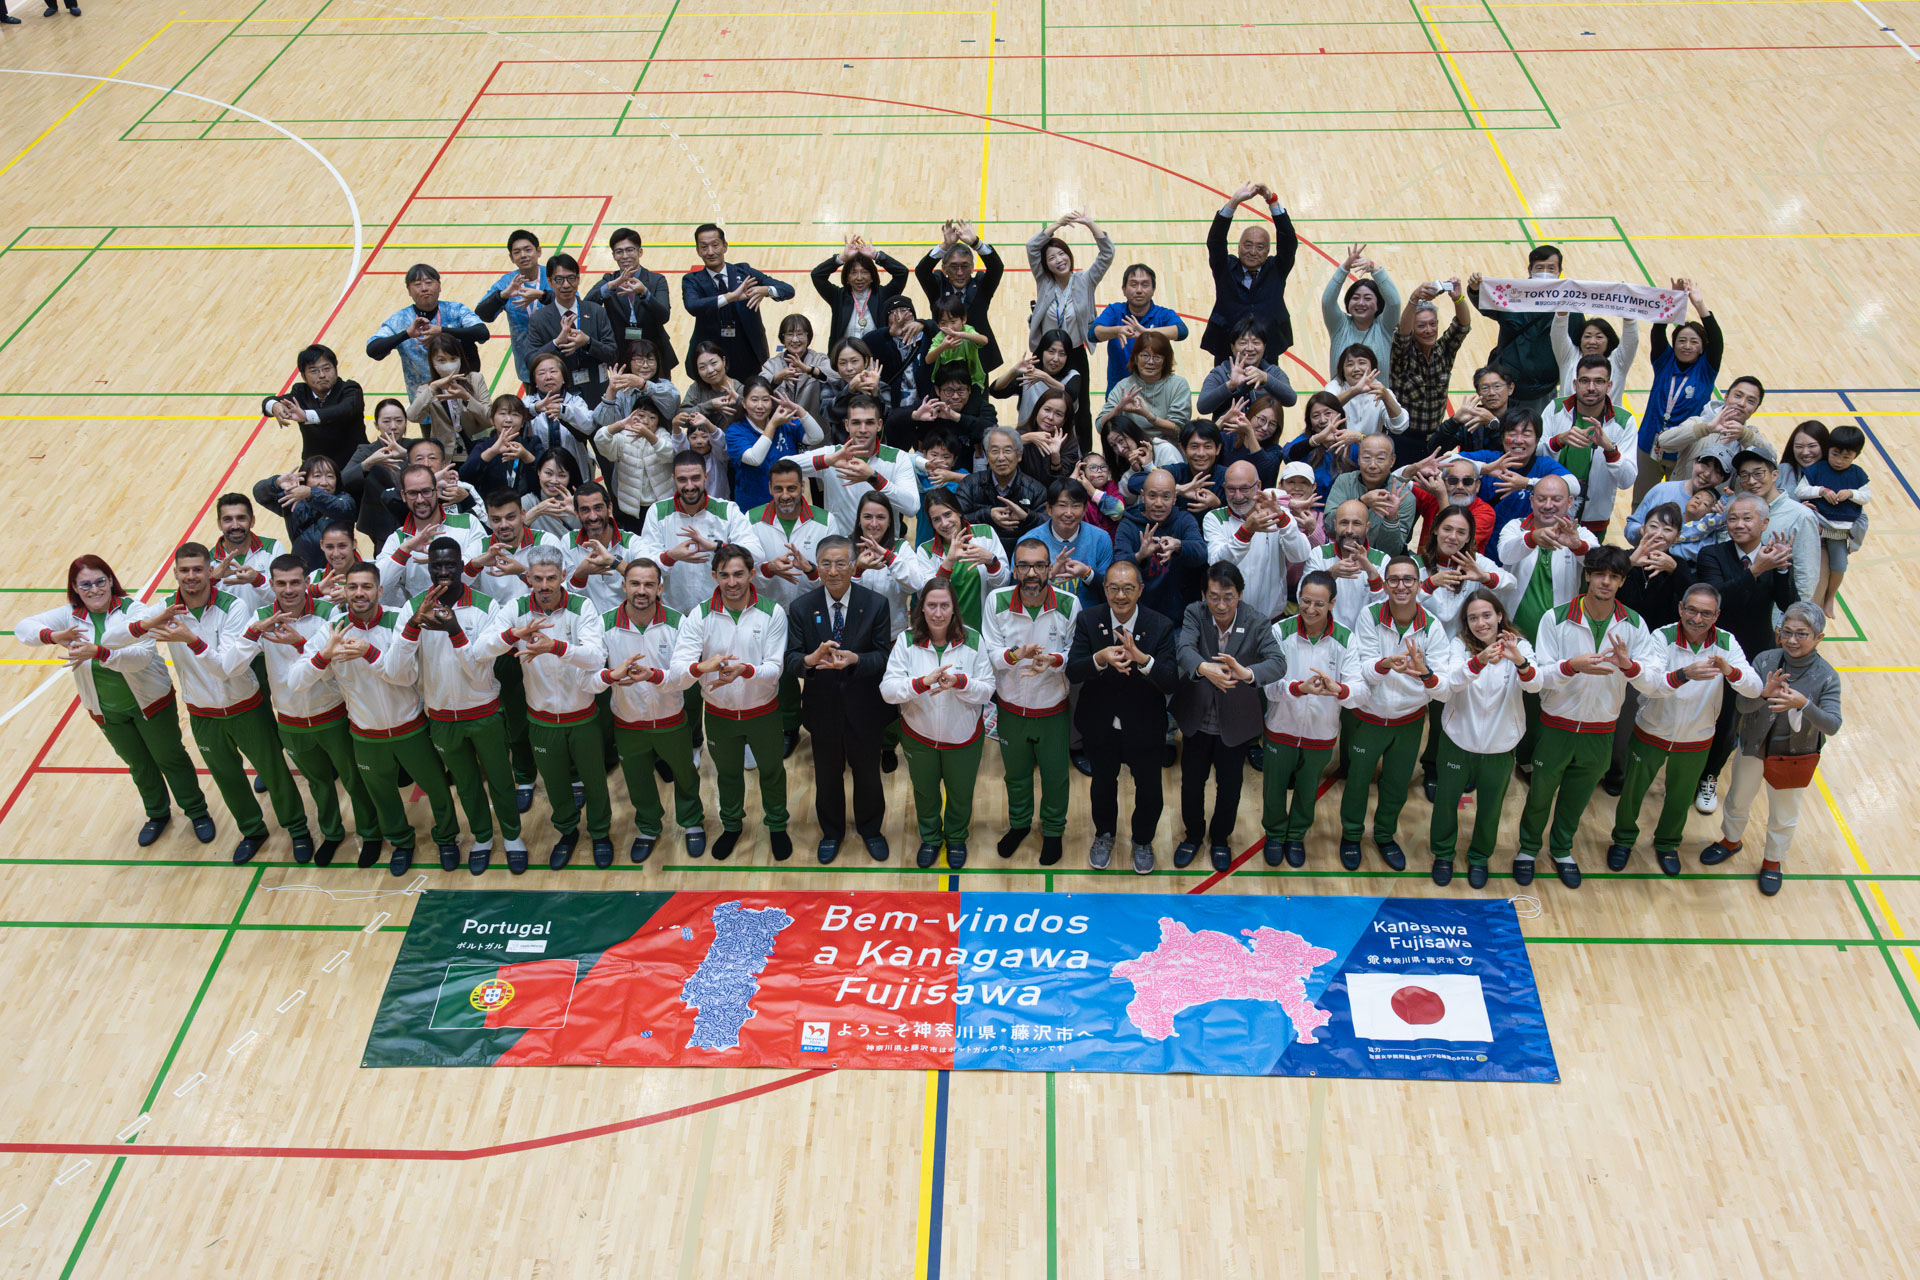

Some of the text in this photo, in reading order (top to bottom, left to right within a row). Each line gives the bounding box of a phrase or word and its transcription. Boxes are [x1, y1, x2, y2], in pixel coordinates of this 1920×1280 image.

[1524, 290, 1661, 309] TOKYO 2025 DEAFLYMPICS
[534, 746, 547, 754] POR
[1447, 761, 1461, 770] POR
[462, 919, 551, 938] Portugal
[820, 905, 1090, 934] Bem-vindos
[1374, 920, 1468, 935] Kanagawa
[456, 941, 504, 951] ポルトガル
[1390, 935, 1472, 951] Fujisawa
[813, 939, 1090, 973] a Kanagawa
[835, 976, 1042, 1011] Fujisawa
[837, 1021, 1095, 1043] ようこそ神奈川県・藤沢市へ
